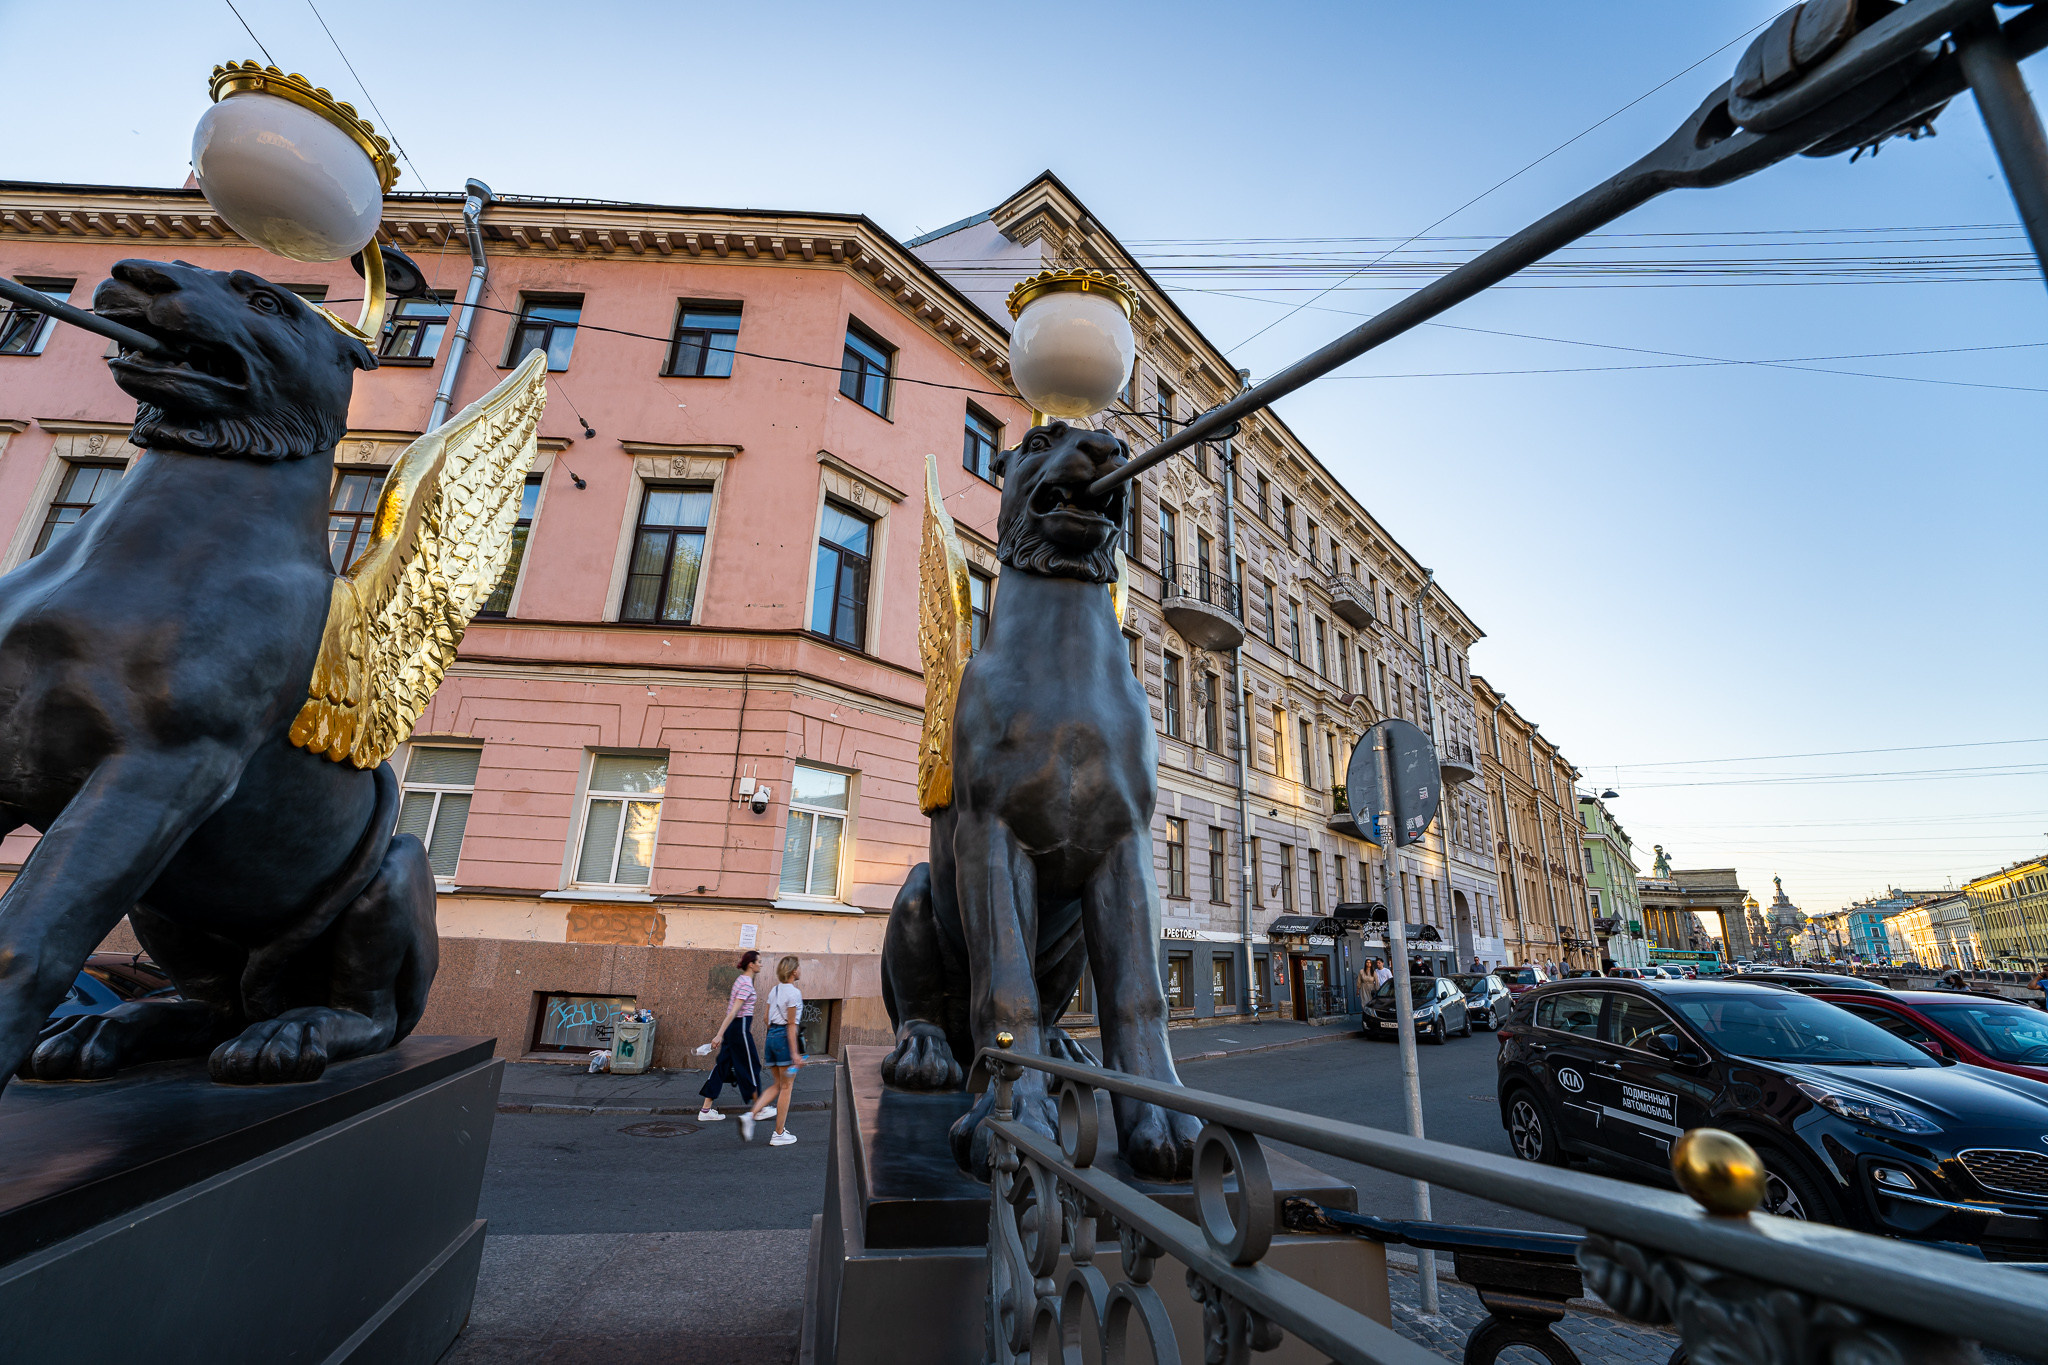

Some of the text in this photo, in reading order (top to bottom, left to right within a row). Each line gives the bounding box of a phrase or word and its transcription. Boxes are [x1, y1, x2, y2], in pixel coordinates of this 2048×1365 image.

[1166, 928, 1200, 939] РЕСТОБАР
[1561, 1070, 1581, 1090] KIA
[1622, 1085, 1671, 1107] ПОДМЕННЫЙ
[1622, 1098, 1673, 1120] АВТОМОБИЛЬ
